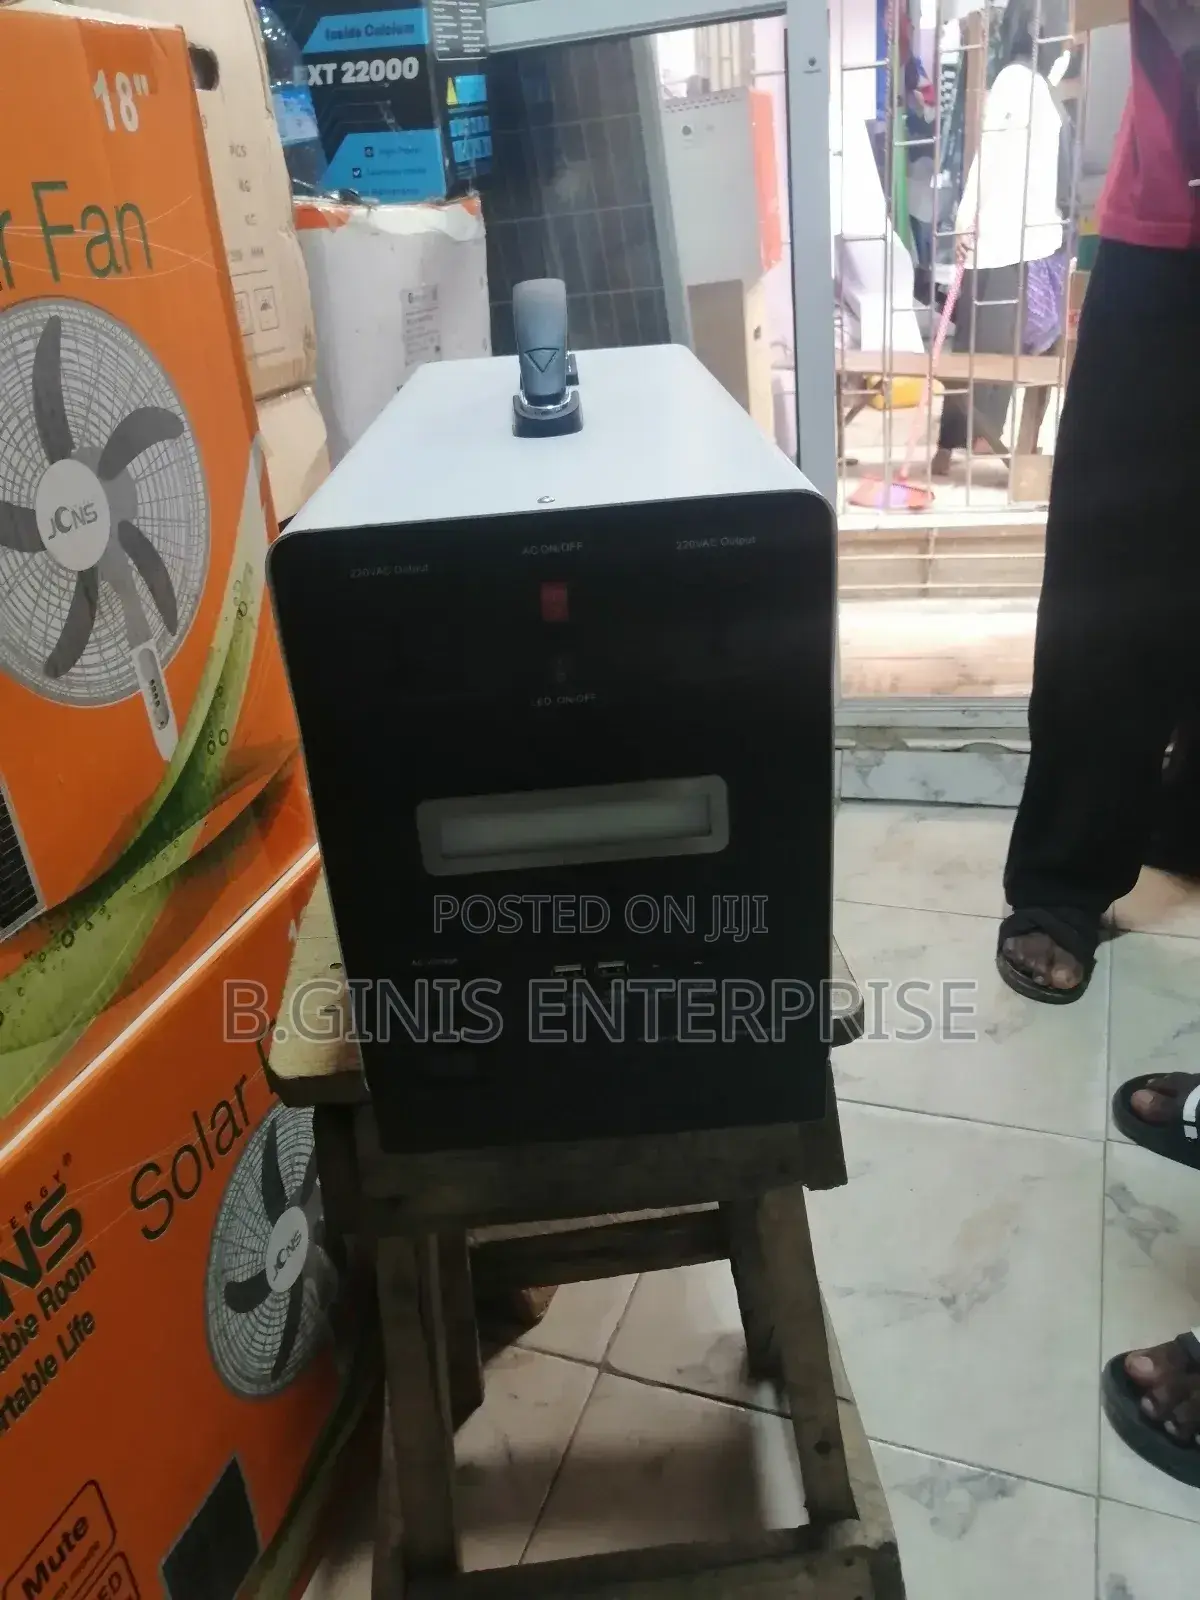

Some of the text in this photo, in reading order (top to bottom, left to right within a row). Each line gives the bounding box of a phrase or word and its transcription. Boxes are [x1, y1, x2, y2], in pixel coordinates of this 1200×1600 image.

[93, 69, 149, 132] 18"
[341, 56, 419, 84] 22000
[31, 181, 153, 283] Fan
[48, 502, 98, 540] JCNS
[720, 534, 757, 547] Output
[130, 1074, 250, 1241] Solar
[37, 1250, 97, 1321] Room
[57, 1311, 95, 1362] Life
[22, 1516, 89, 1600] Mute
